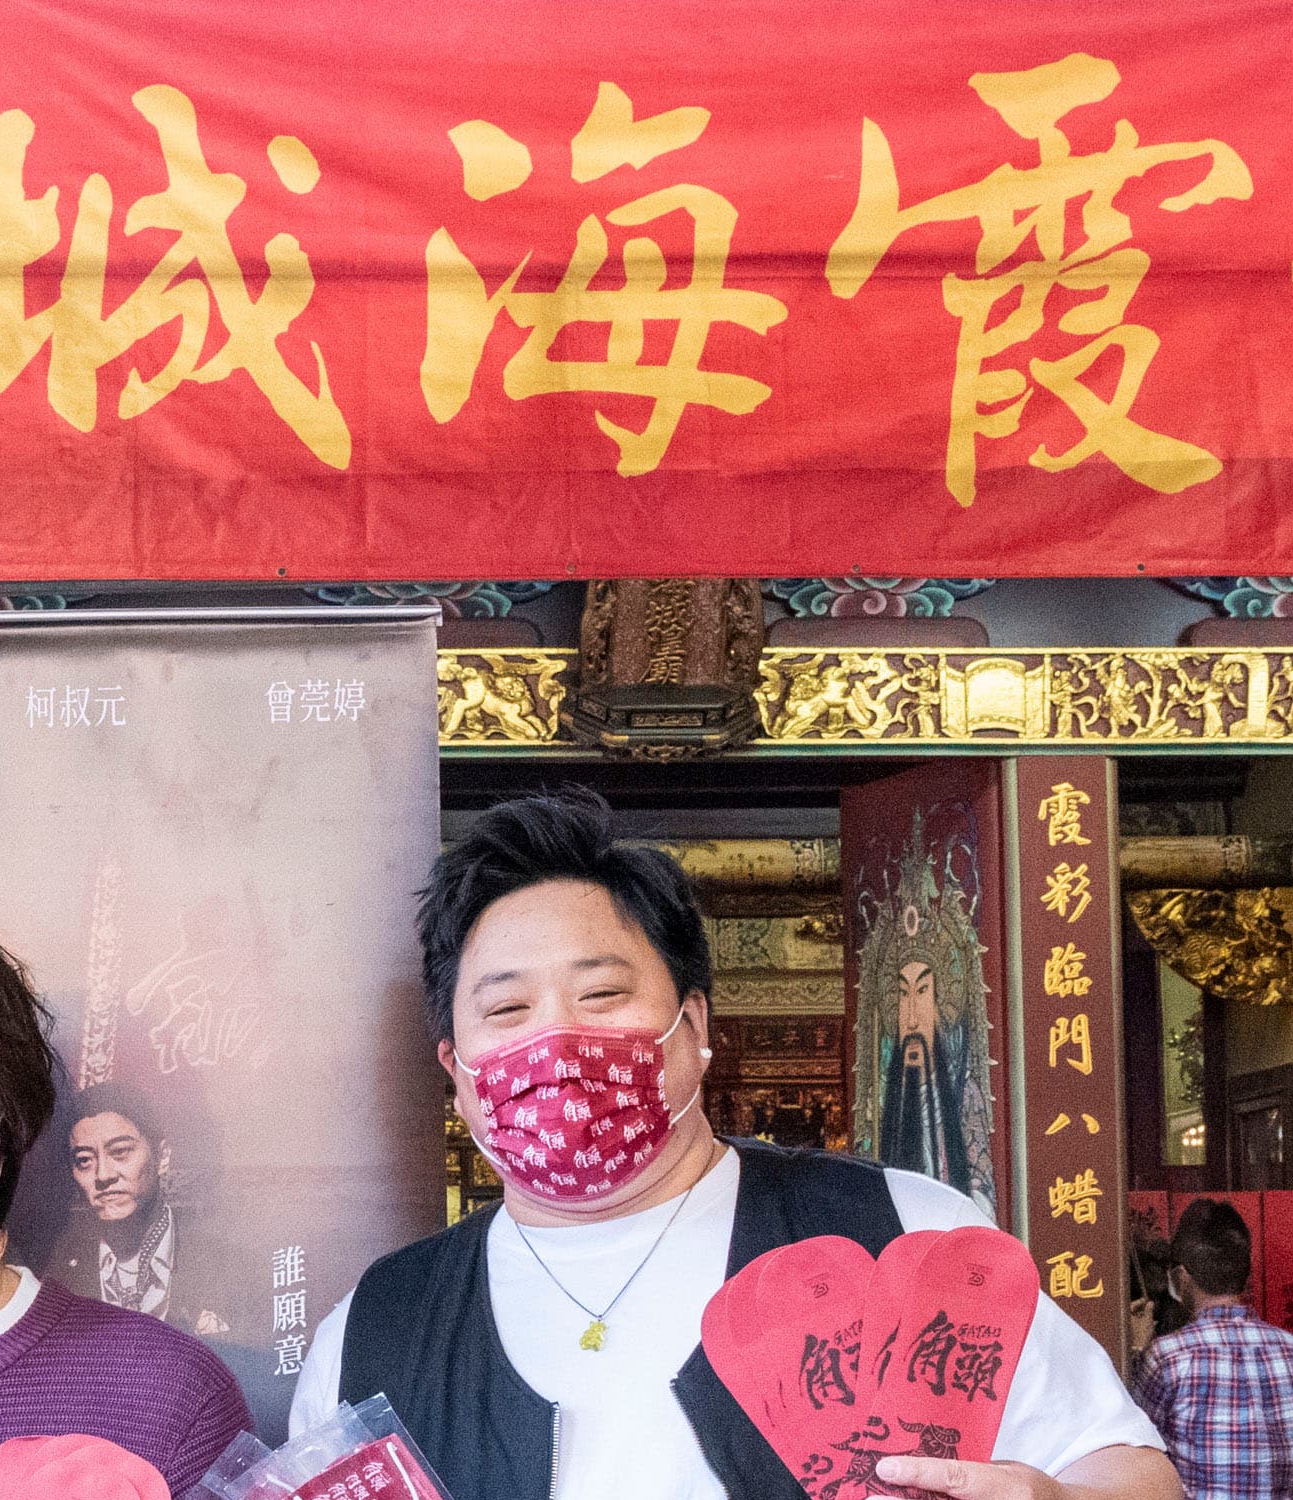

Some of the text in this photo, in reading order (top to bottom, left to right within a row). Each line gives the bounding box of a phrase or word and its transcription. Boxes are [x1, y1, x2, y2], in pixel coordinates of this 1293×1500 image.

[25, 683, 127, 730] 柯叔元
[264, 679, 368, 725] 曾莞婷
[554, 1058, 582, 1078] 角頭
[608, 1064, 633, 1085] 角頭
[563, 1099, 592, 1122] 角頭
[539, 1129, 566, 1150] 角頭
[272, 1246, 307, 1378] 誰願意
[957, 1323, 1003, 1338] GATAO
[904, 1309, 1004, 1403] 角頭
